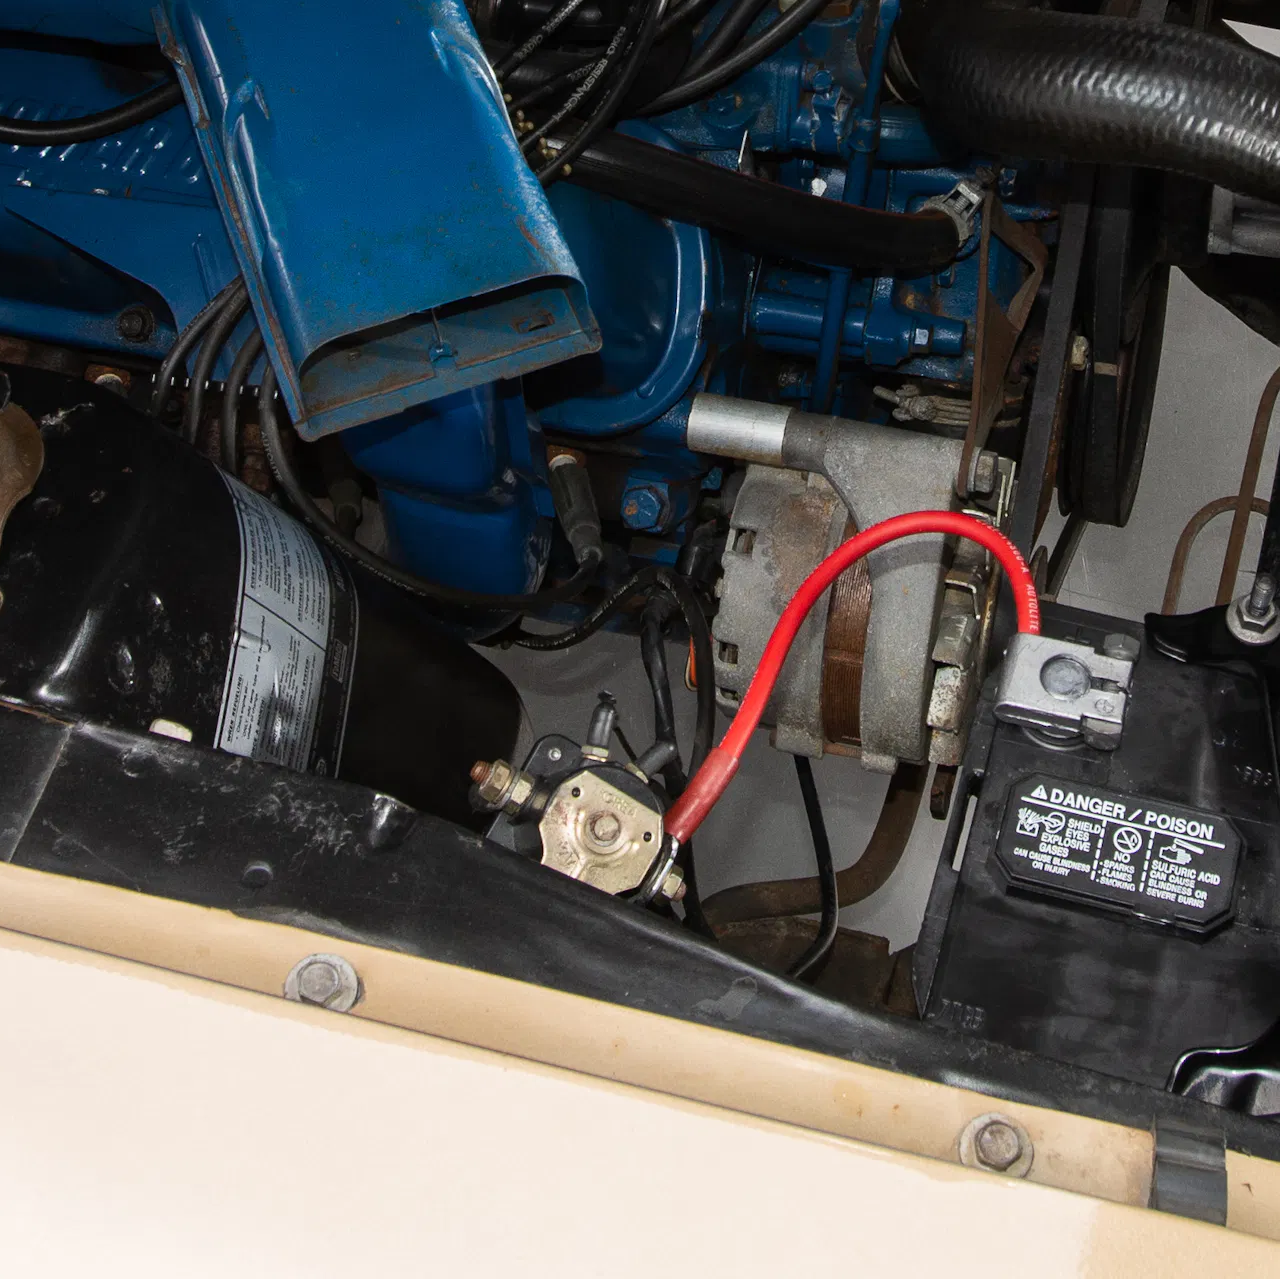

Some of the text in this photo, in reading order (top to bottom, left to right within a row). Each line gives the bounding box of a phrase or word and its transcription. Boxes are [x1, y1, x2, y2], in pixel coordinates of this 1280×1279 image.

[1025, 583, 1039, 632] AUTOLITE
[1050, 788, 1213, 840] DANGER / POISON
[1065, 828, 1090, 842] EYES
[1067, 818, 1101, 834] SHIELD
[1039, 842, 1069, 858] GASES
[1041, 832, 1091, 852] EXPLOSIVE
[1013, 847, 1091, 873] CAN CAUSE BLINDNESS
[1113, 851, 1131, 863] NO
[1032, 861, 1070, 876] OR INJURY
[1151, 860, 1220, 885] SULFURIC ACID
[1150, 870, 1195, 888] CAN CAUSE
[1146, 887, 1205, 908] SEVERE BURNS
[1148, 879, 1207, 900] BLINDNESS OR
